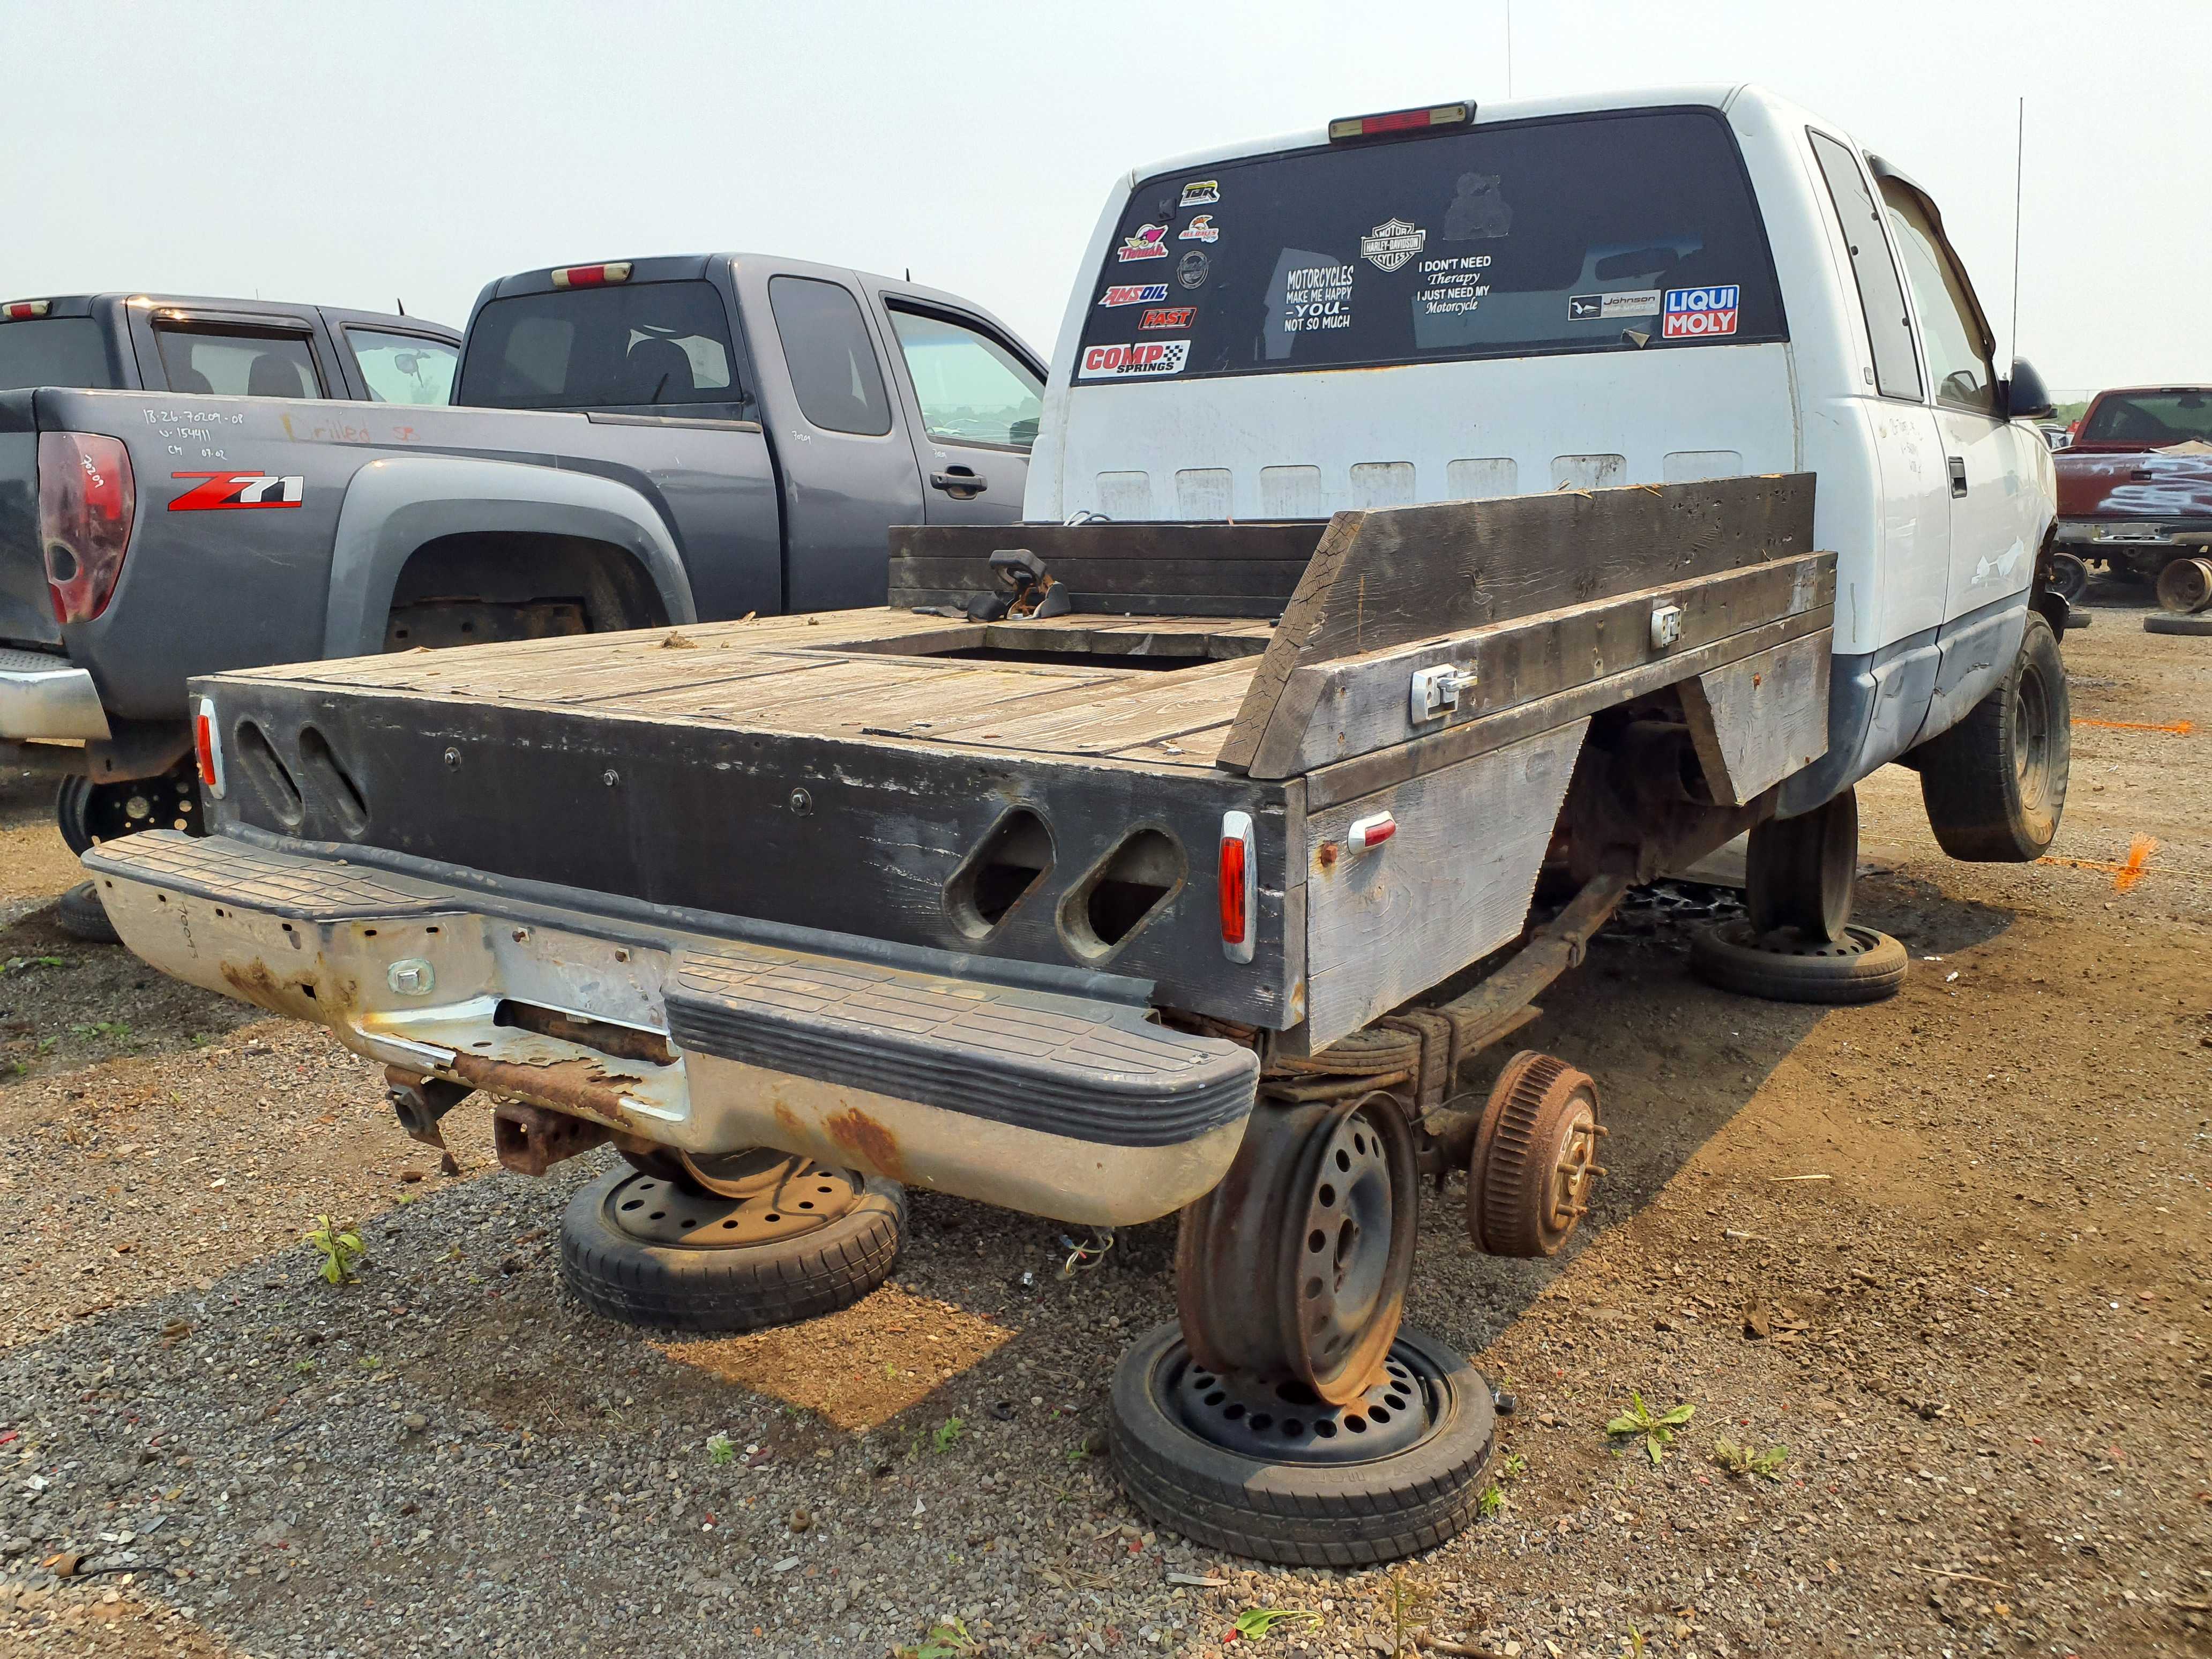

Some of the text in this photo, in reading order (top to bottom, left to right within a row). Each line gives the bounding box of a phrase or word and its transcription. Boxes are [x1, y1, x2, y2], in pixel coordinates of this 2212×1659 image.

[1379, 225, 1407, 237] MOTOR
[1366, 237, 1419, 252] HARLEY-DAVIDSON
[1378, 252, 1406, 266] CYCLES
[1418, 256, 1491, 273] I DON'T NEED
[1287, 265, 1354, 290] MOTORCYCLES
[1428, 272, 1480, 286] Therapy
[1103, 286, 1165, 305] AMSOIL
[1286, 286, 1352, 304] MAKE ME HAPPY
[1417, 285, 1490, 302] I JUST NEED MY
[1604, 296, 1655, 305] Johnson
[1669, 288, 1734, 311] LIQUI
[1425, 296, 1478, 316] Motorcycle
[1144, 311, 1190, 326] FAST
[1284, 315, 1350, 332] NOT SO MUCH
[1668, 311, 1735, 334] MOLY
[1086, 346, 1163, 370] COMP
[1117, 362, 1175, 373] SPRINGS
[168, 472, 304, 511] Z71
